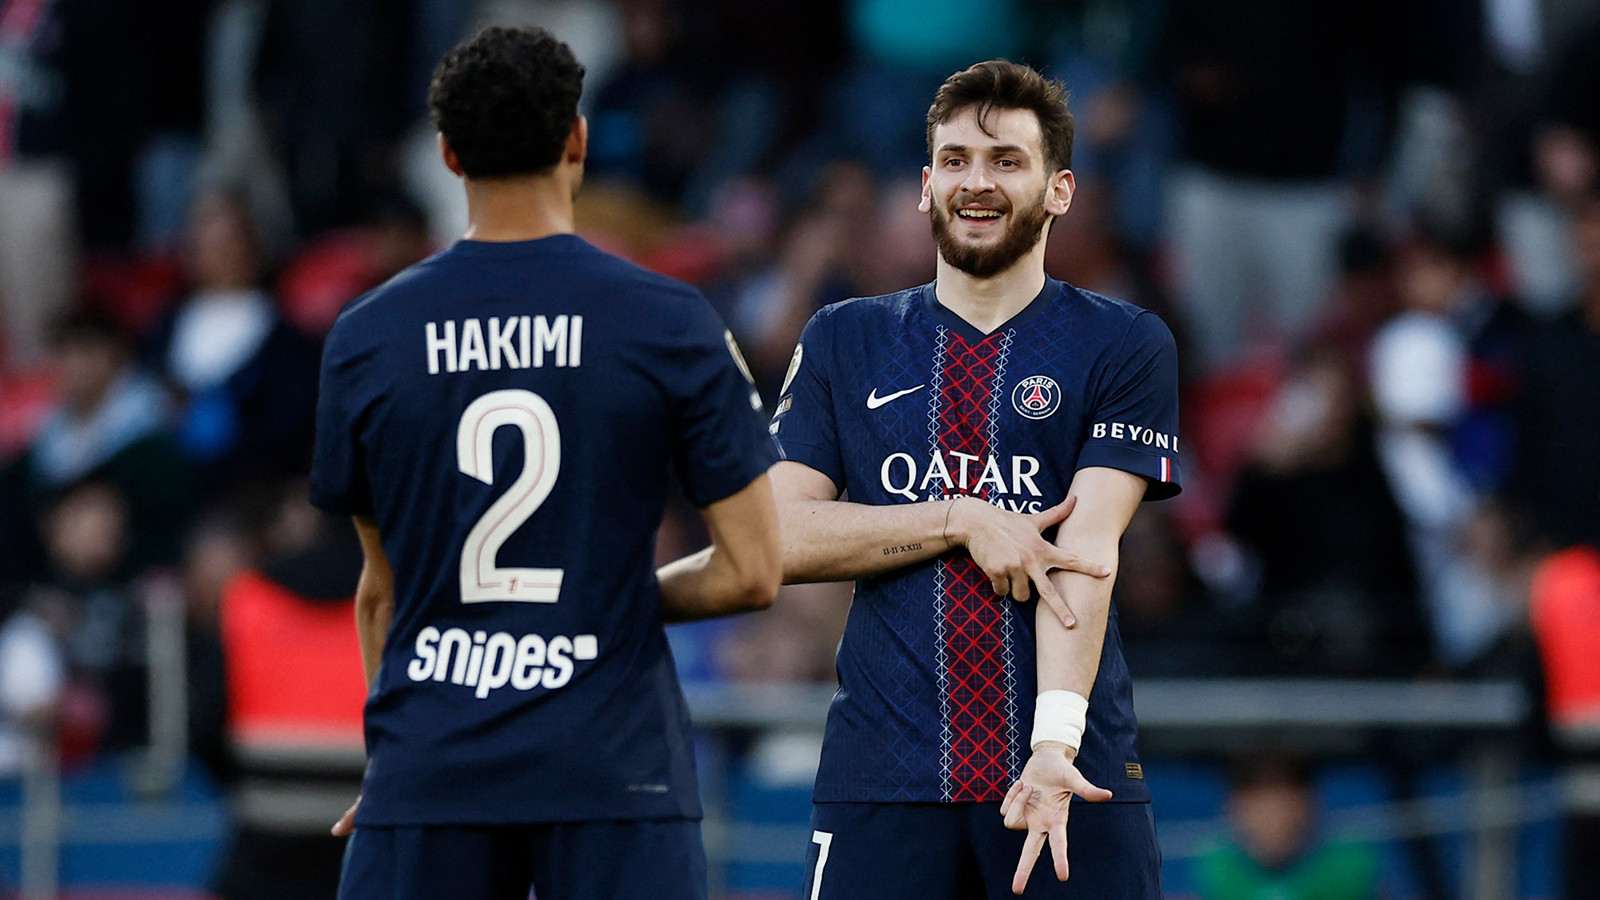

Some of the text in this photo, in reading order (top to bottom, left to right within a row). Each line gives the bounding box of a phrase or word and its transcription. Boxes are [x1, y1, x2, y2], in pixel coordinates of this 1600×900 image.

[425, 315, 583, 375] HAKIMI
[1021, 378, 1054, 388] PARIS
[457, 389, 563, 603] 2
[880, 448, 1043, 502] QATAR
[407, 626, 575, 699] snipes
